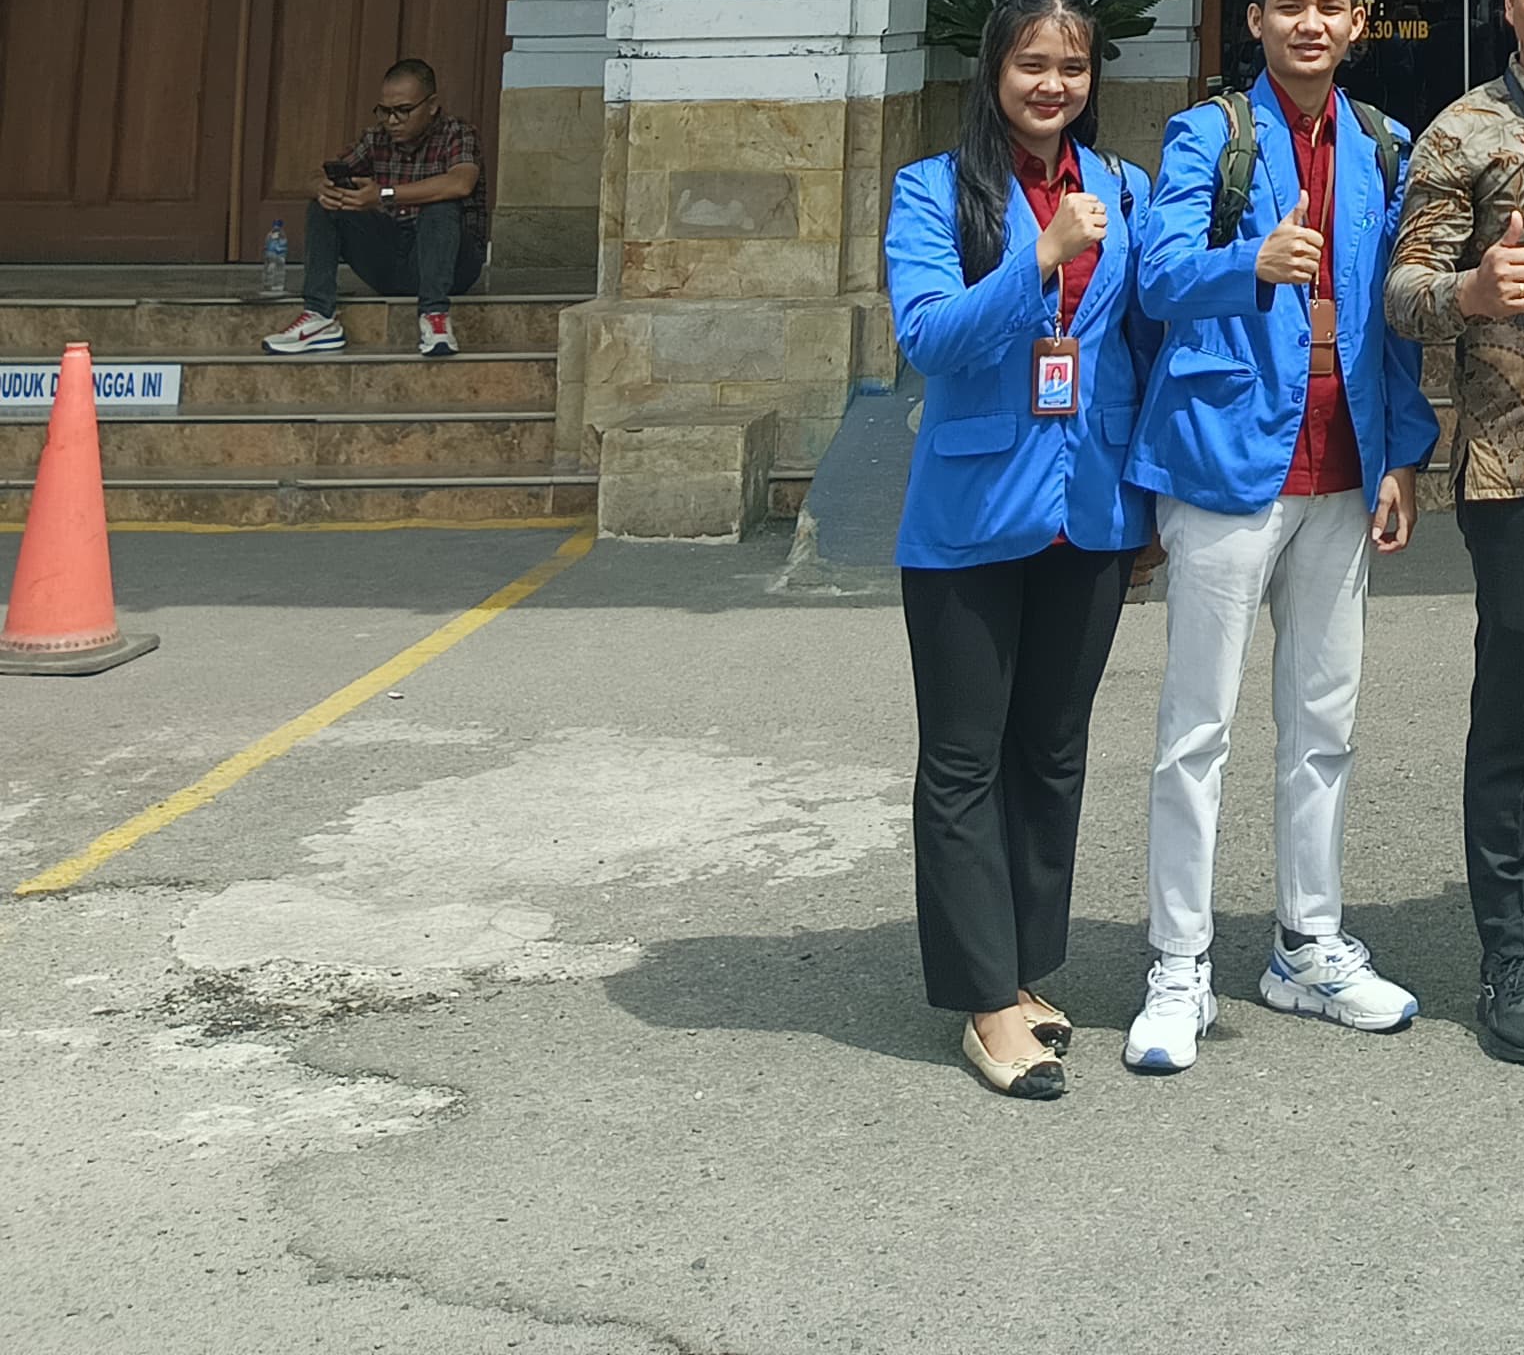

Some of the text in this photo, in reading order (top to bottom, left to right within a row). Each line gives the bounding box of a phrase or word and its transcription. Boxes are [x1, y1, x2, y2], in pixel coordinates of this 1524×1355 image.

[1398, 21, 1429, 39] WIB
[0, 373, 46, 398] UDUK
[142, 372, 163, 397] INI
